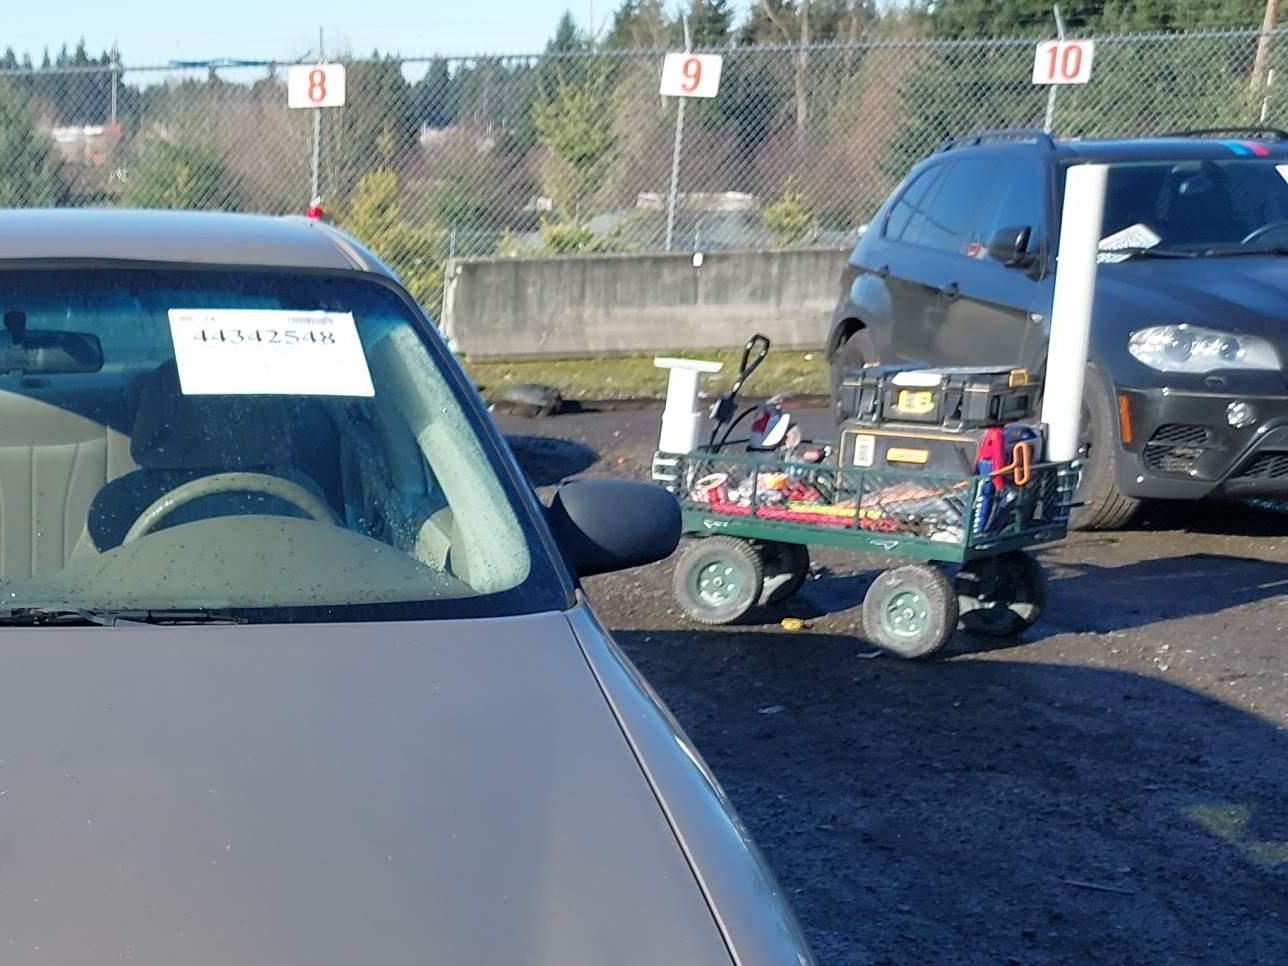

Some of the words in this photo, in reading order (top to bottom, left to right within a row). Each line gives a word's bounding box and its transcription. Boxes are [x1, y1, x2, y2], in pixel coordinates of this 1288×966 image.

[682, 56, 701, 94] 9
[1047, 43, 1082, 80] 10
[308, 67, 326, 105] 8
[193, 329, 336, 345] 44342548
